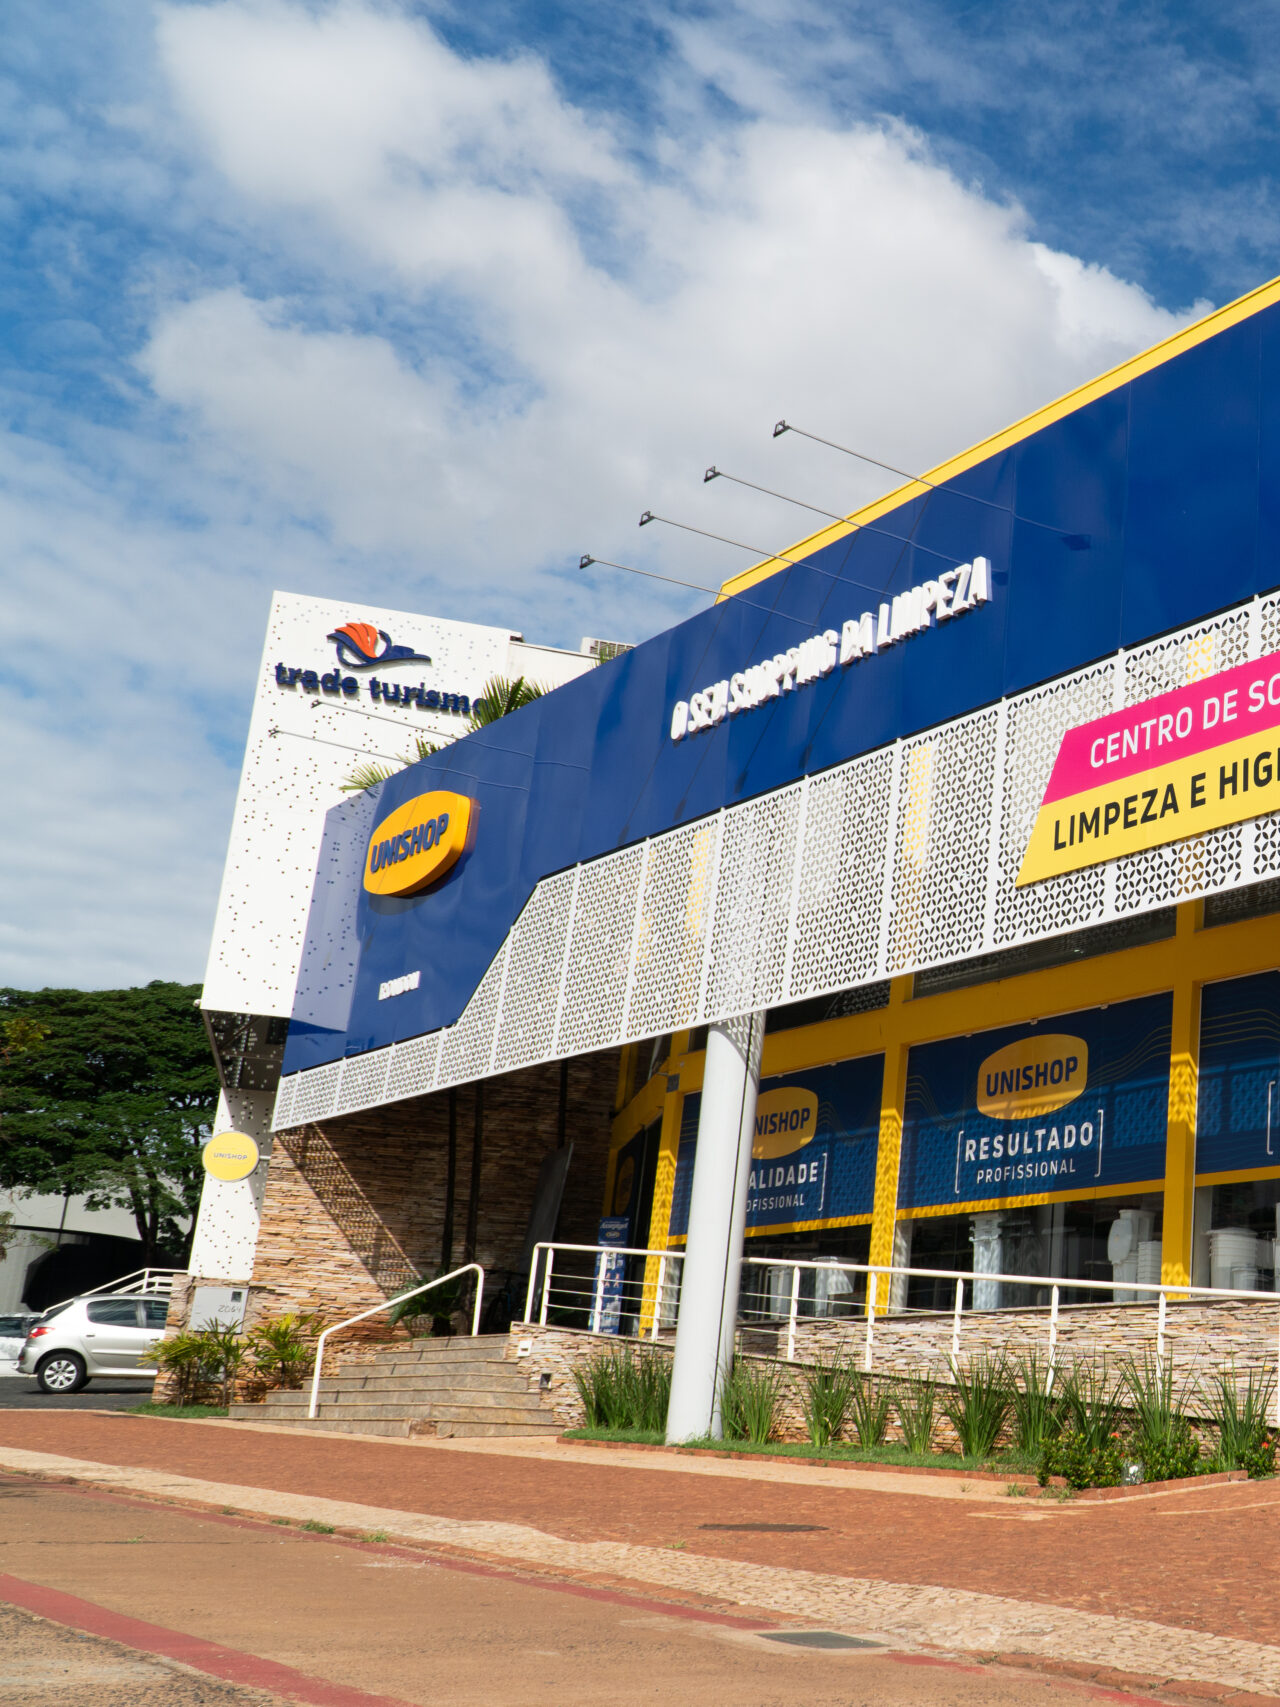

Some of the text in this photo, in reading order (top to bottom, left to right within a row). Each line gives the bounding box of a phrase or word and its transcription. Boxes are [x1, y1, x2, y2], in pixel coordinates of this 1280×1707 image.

[275, 662, 359, 695] trade
[1089, 706, 1193, 769] CENTRO
[1202, 689, 1239, 731] DE
[1053, 782, 1180, 852] LIMPEZA
[1190, 771, 1207, 809] E
[370, 812, 450, 874] UNISHOP
[985, 1055, 1079, 1097] UNISHOP
[753, 1107, 811, 1136] NISHOP
[964, 1121, 1094, 1162] RESULTADO
[748, 1160, 819, 1190] ALIDADE
[976, 1158, 1077, 1185] PROFISSIONAL
[746, 1193, 805, 1213] OFISSIONAL
